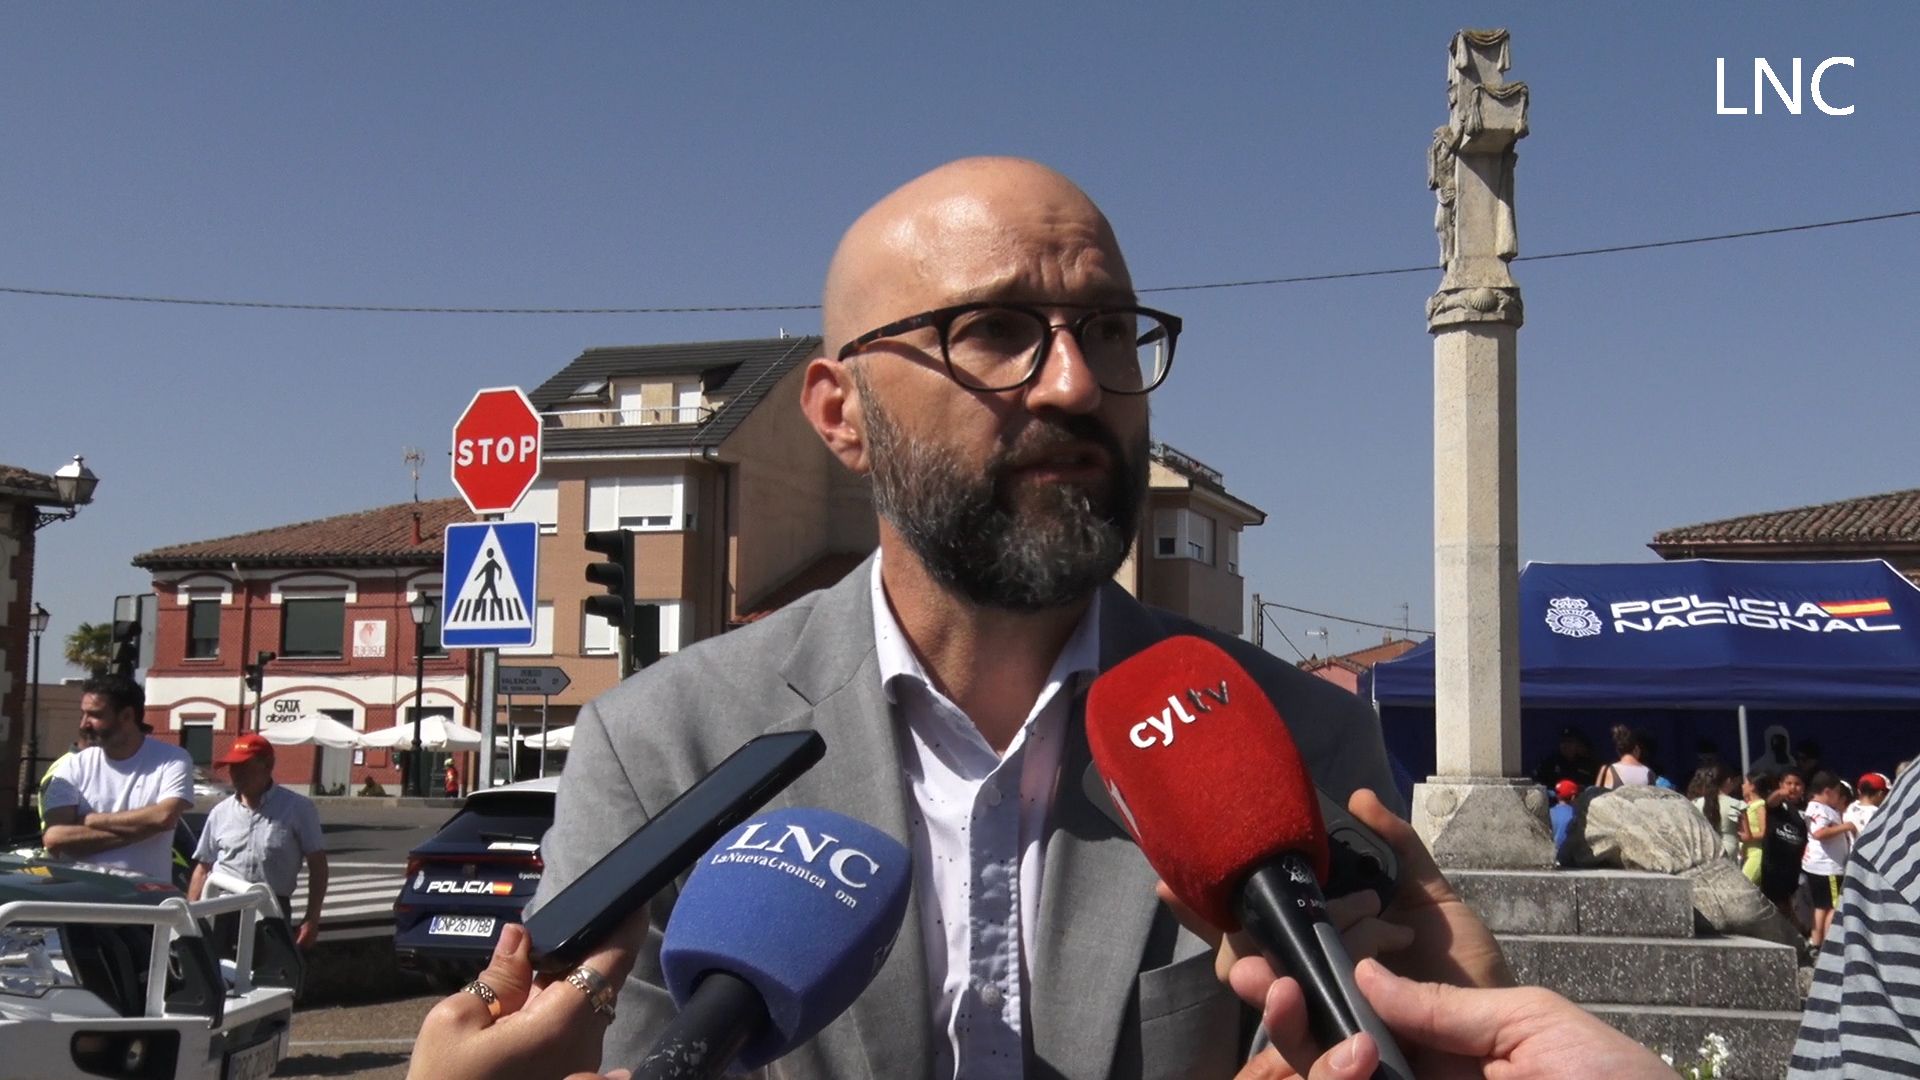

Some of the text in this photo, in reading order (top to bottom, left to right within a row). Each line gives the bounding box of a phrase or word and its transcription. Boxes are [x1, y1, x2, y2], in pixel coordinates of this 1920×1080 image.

[456, 435, 537, 467] STOP
[1610, 594, 1831, 619] POLICIA
[1613, 608, 1901, 633] NACIONAL
[273, 699, 301, 713] GAIA
[726, 822, 881, 888] LNC
[426, 880, 494, 894] POLICIA
